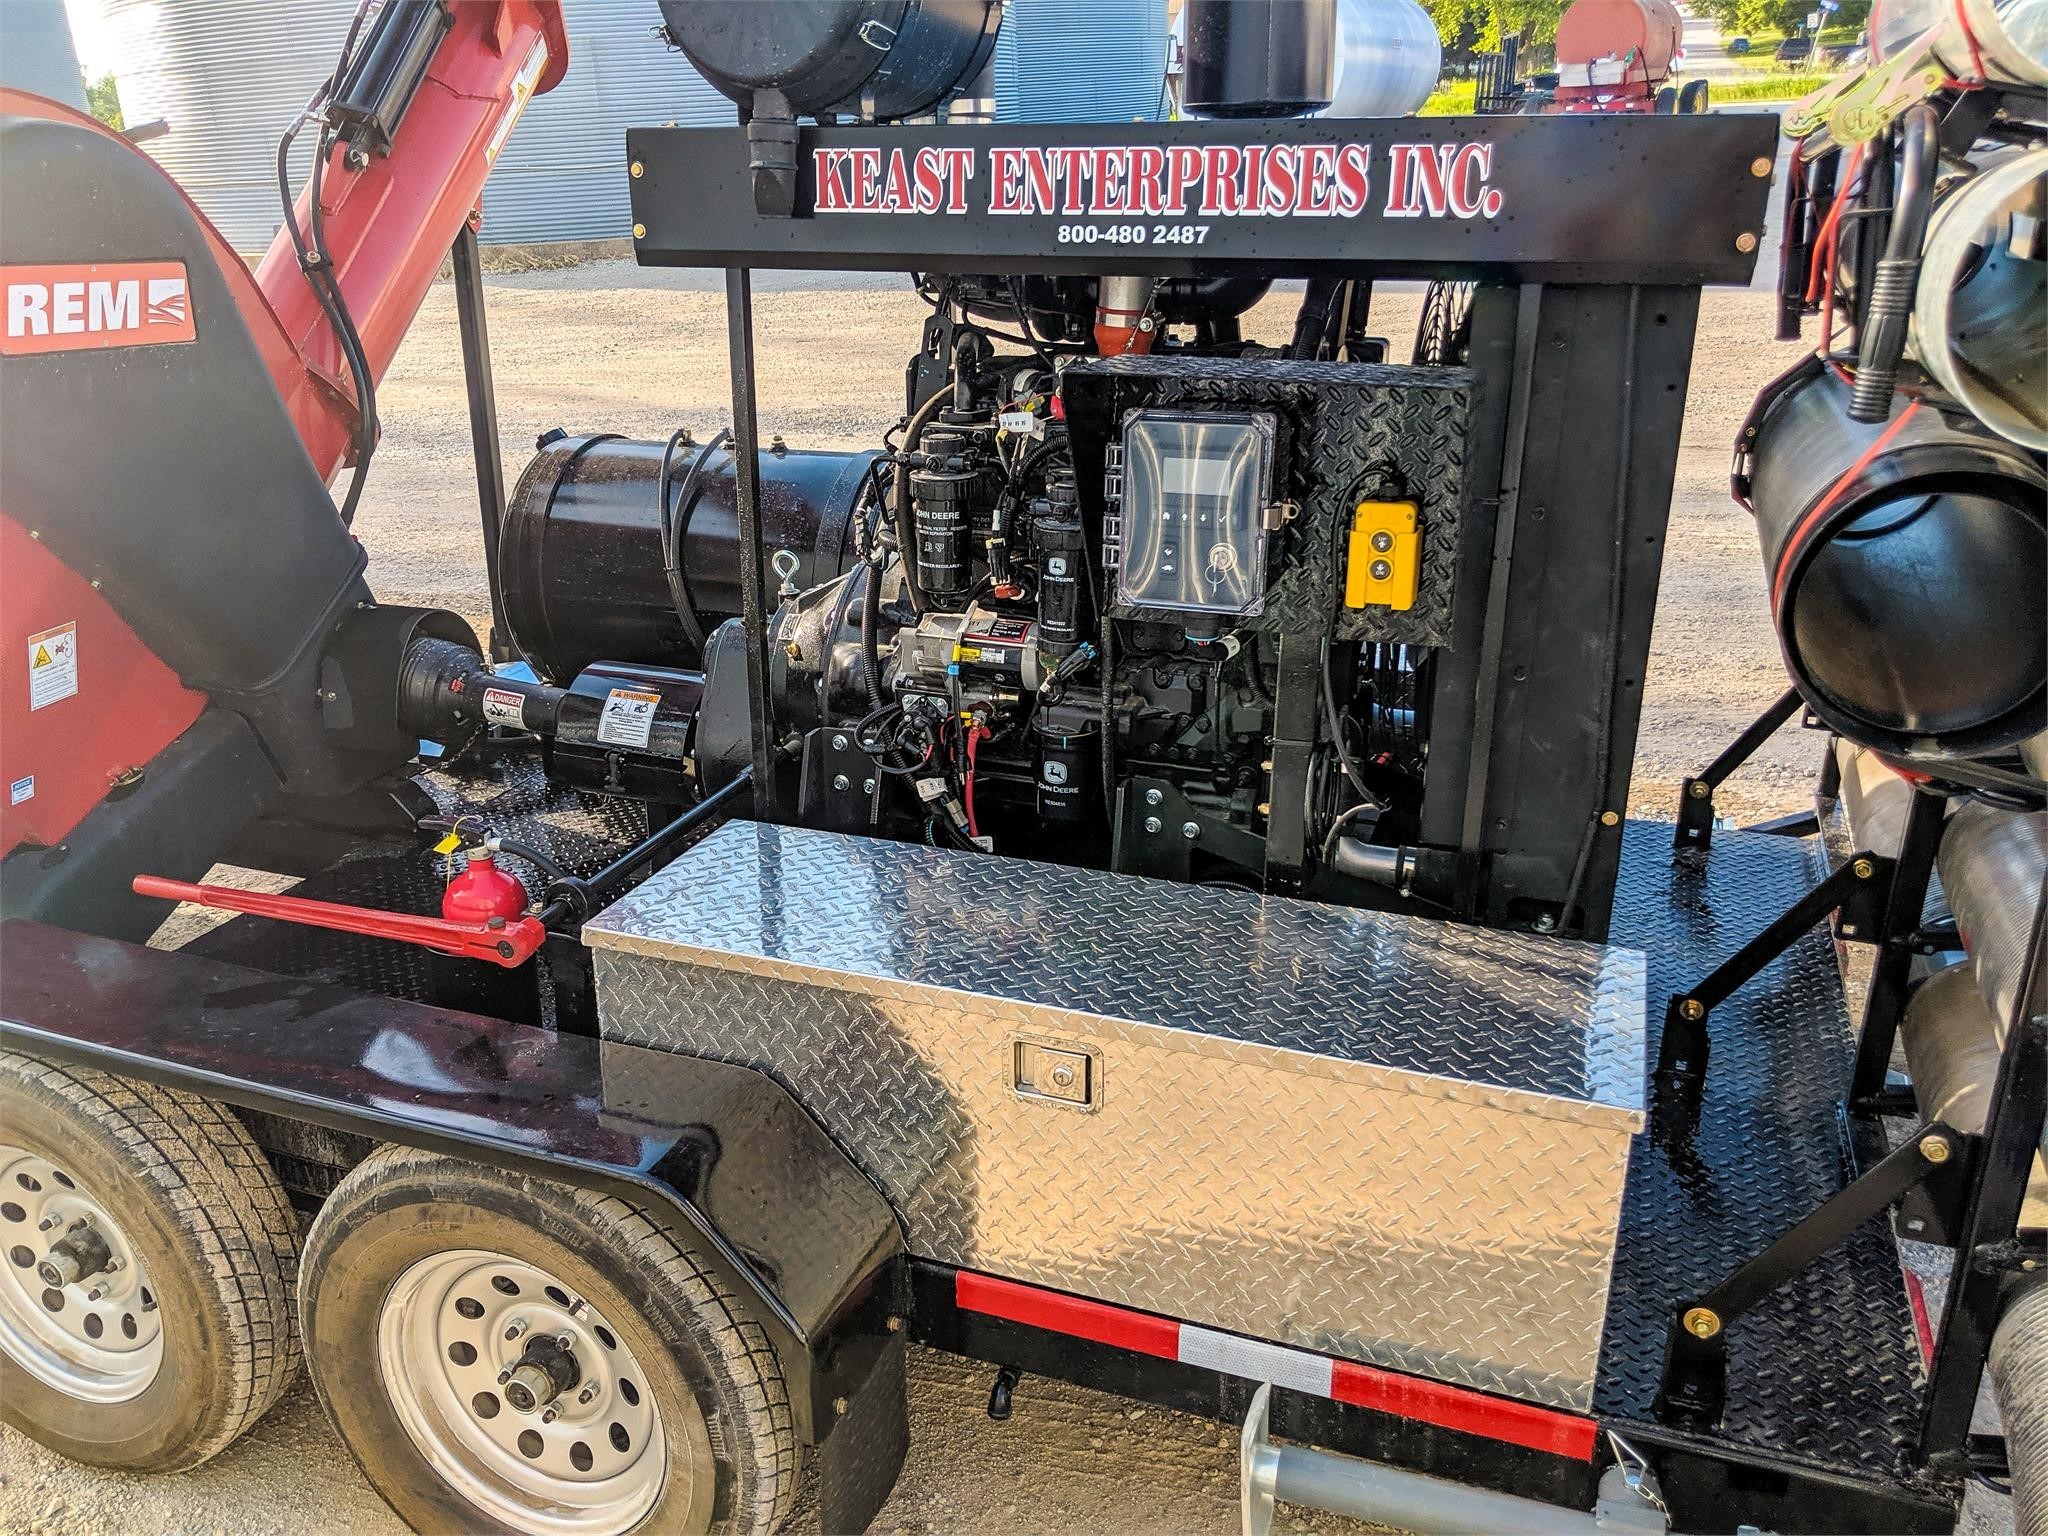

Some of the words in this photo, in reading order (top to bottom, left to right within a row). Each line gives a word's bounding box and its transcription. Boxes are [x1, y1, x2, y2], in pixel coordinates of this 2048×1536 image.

[813, 147, 974, 215] KEAST
[988, 145, 1370, 217] ENTERPRISES
[1383, 144, 1503, 219] INC.
[1057, 225, 1146, 244] 800-480
[1152, 225, 1210, 244] 2487
[8, 280, 140, 337] REM
[931, 511, 960, 520] DEERE
[494, 693, 521, 706] DANGER
[623, 692, 653, 702] WARNING
[1037, 780, 1053, 792] JOHN
[1053, 785, 1079, 794] DEERE
